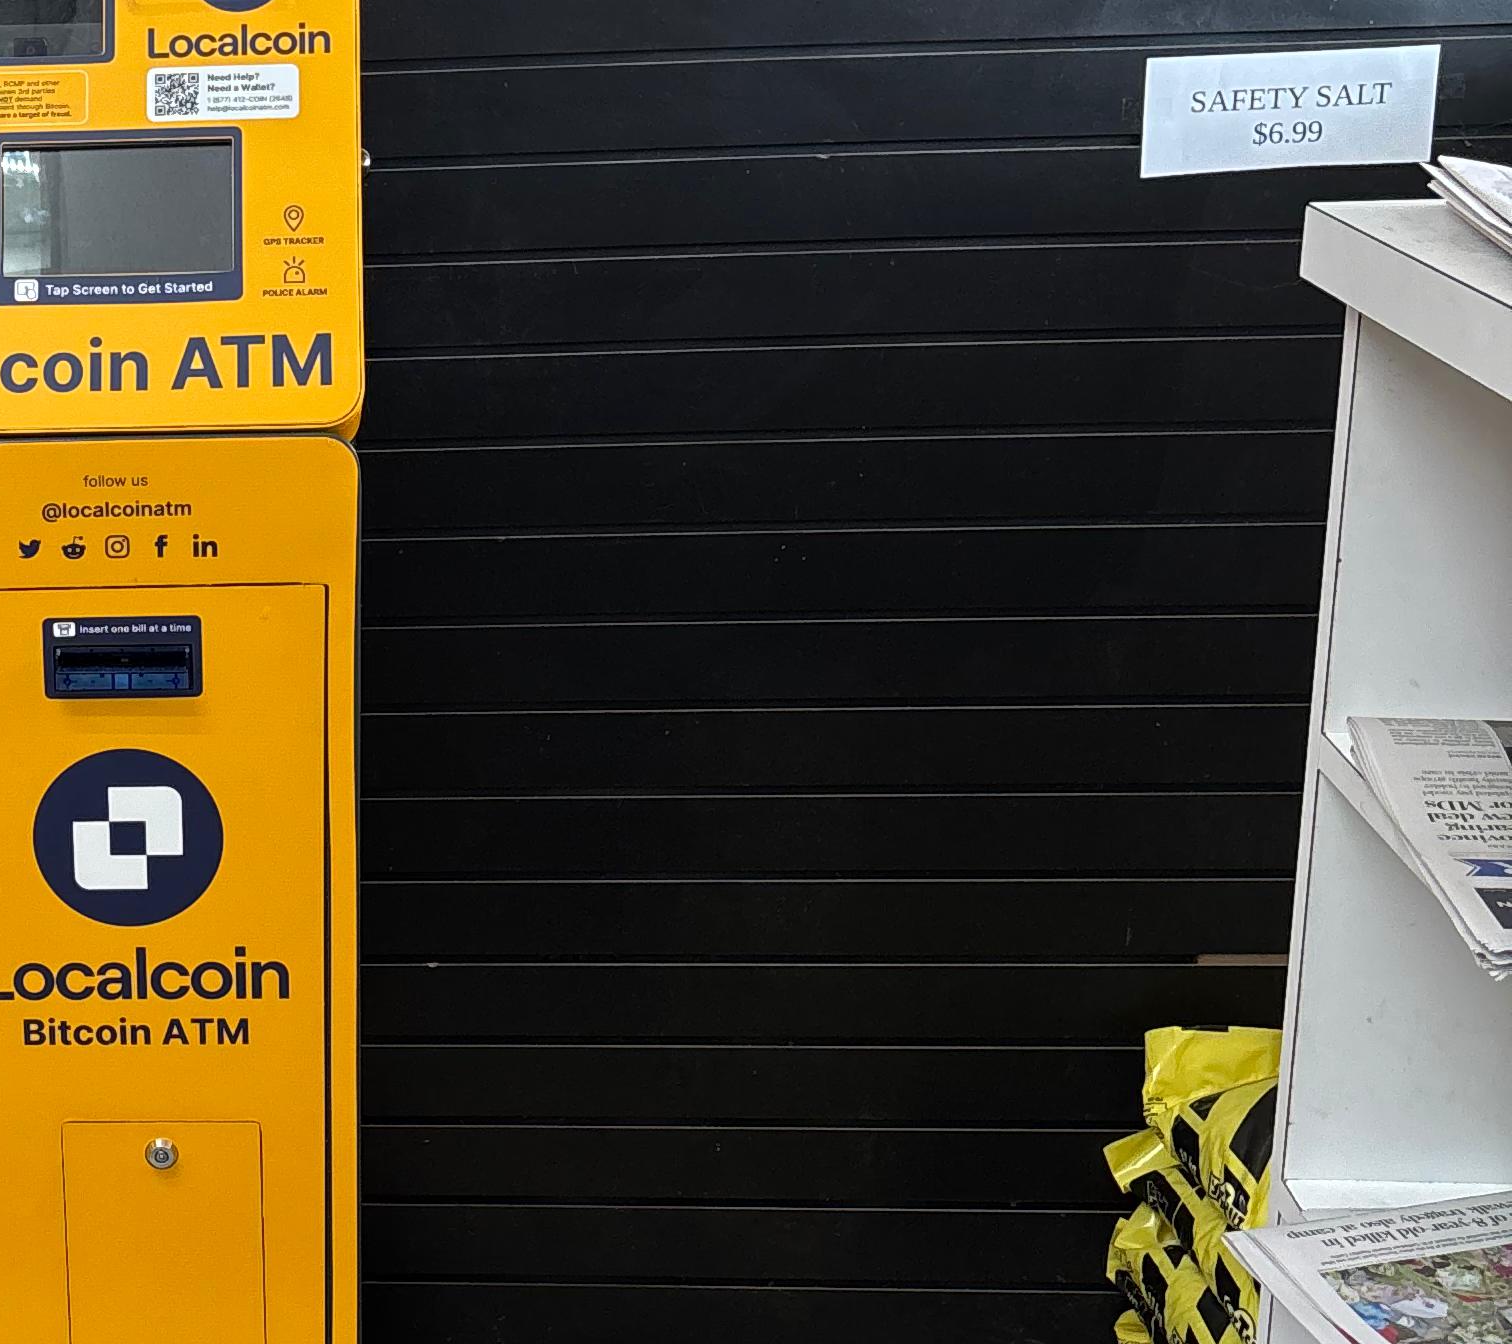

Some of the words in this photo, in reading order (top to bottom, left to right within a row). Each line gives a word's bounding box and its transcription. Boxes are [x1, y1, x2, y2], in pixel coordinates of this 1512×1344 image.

[148, 24, 331, 59] Localcoin
[1191, 87, 1308, 113] SAFETY
[1316, 82, 1392, 108] SALT
[1253, 121, 1323, 146] $6.99
[46, 284, 69, 297] Tap
[73, 283, 117, 295] Screen
[121, 284, 134, 295] to
[138, 283, 161, 294] Get
[165, 281, 213, 293] Started
[263, 289, 294, 297] POLICE
[296, 288, 327, 296] ALARM
[172, 332, 333, 391] ATM
[84, 475, 126, 487] follow
[132, 476, 148, 486] us
[42, 500, 192, 522] @localcoinatm
[80, 624, 108, 634] Insert
[111, 625, 130, 633] one
[132, 624, 146, 633] bill
[149, 624, 159, 633] at
[170, 623, 191, 633] time
[23, 1017, 151, 1045] Bitcoin
[162, 1019, 249, 1045] ATM
[1360, 1218, 1395, 1229] also
[1287, 1227, 1336, 1239] camp
[1347, 1232, 1395, 1248] killed
[1322, 1239, 1344, 1248] in
